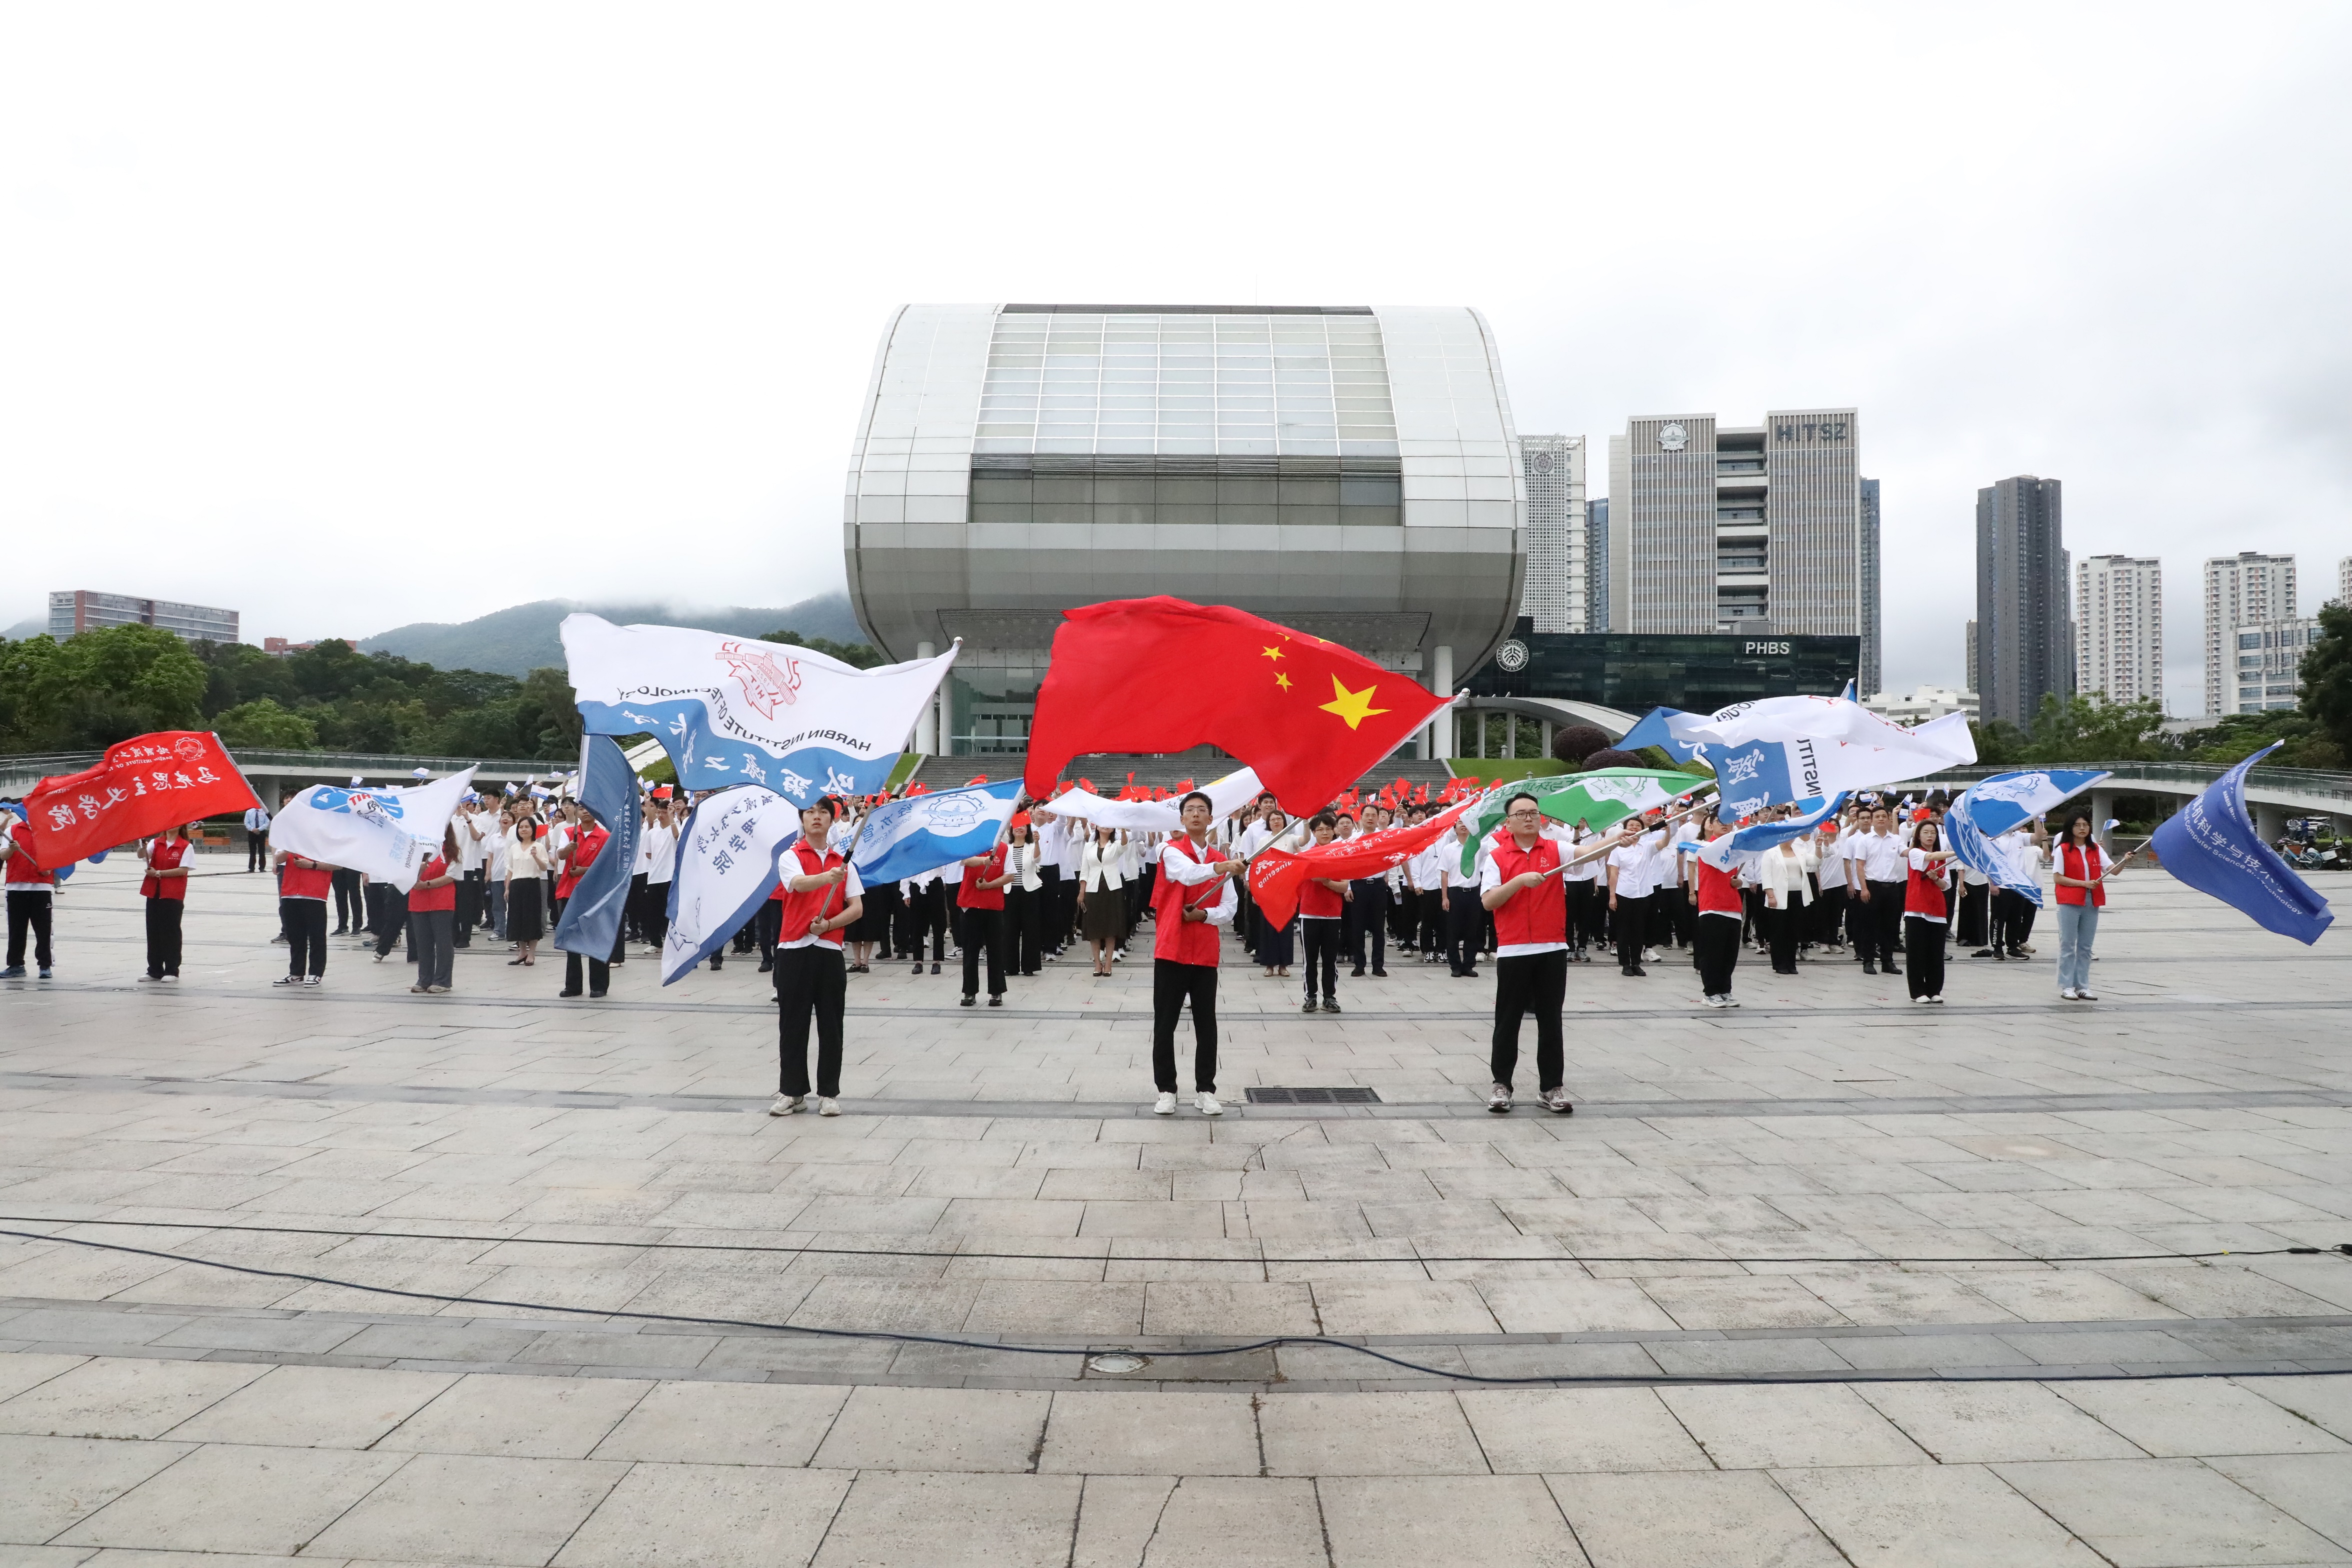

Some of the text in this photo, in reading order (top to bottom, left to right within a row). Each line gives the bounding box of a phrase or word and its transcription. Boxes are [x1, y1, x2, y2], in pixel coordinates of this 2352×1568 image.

[1777, 423, 1846, 441] HITSZ
[1508, 640, 1526, 662] UNIVERSITY
[1746, 642, 1790, 654] PHBS
[2185, 820, 2212, 851] Computer
[2212, 849, 2246, 869] Science
